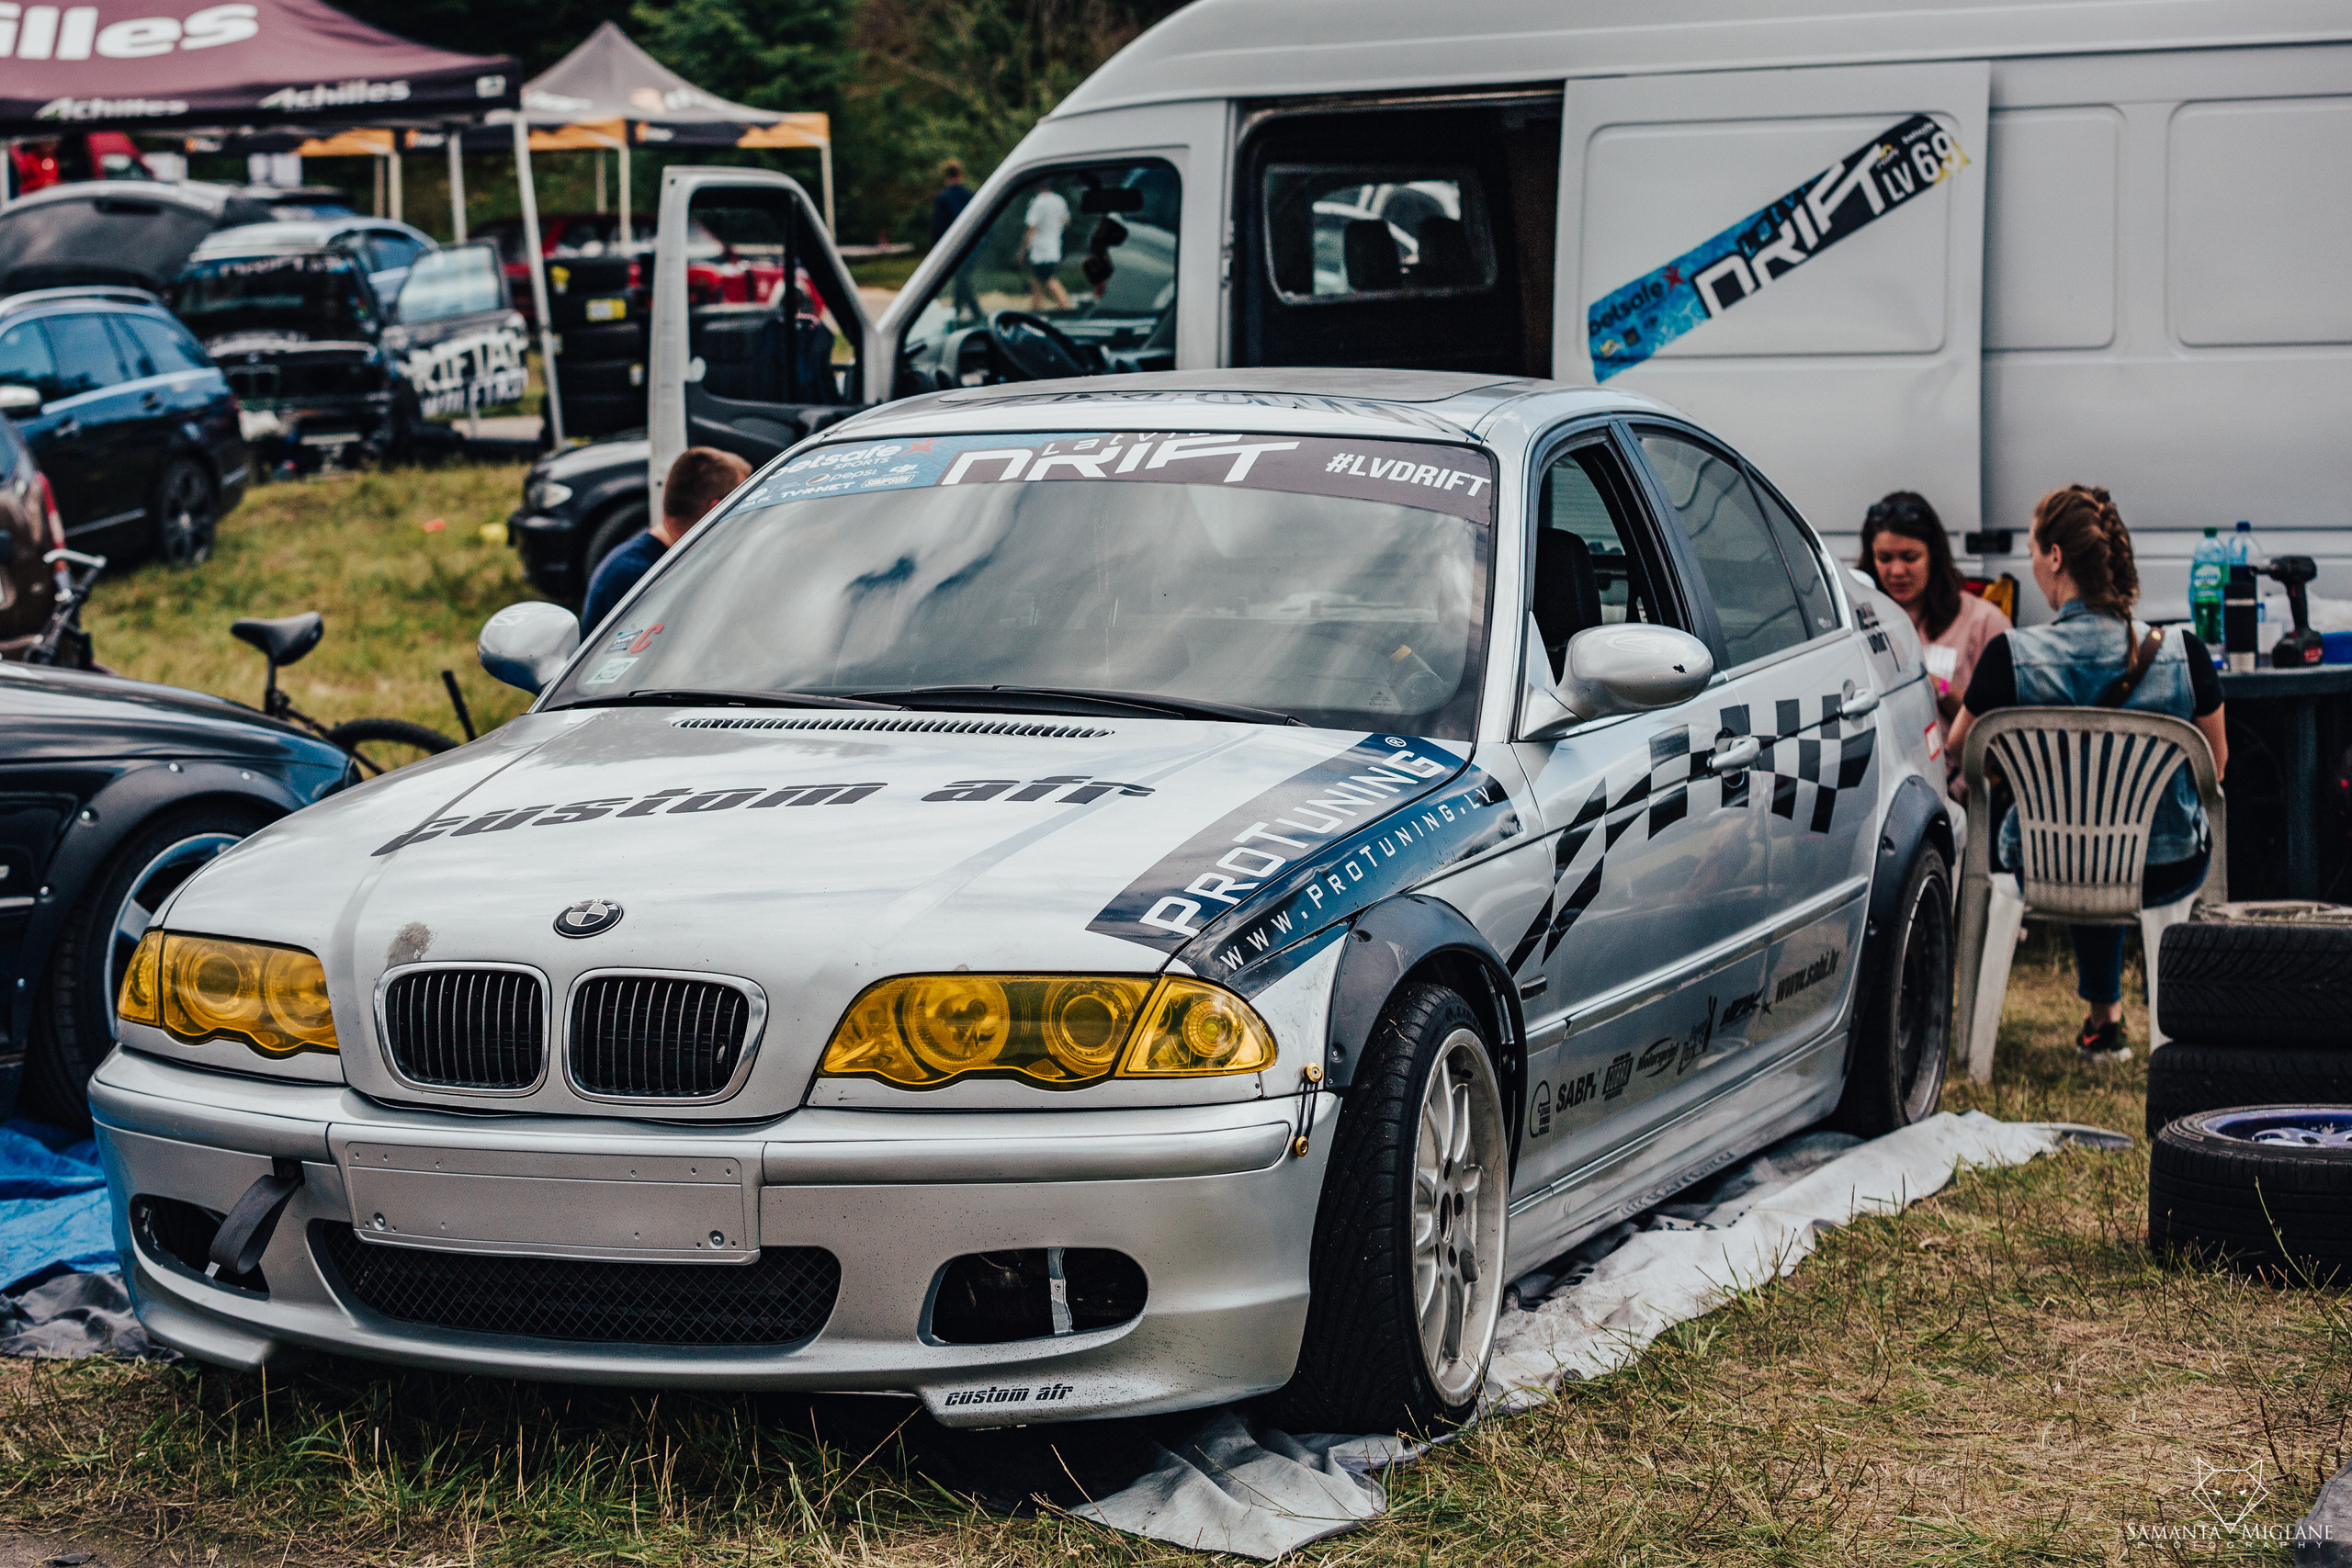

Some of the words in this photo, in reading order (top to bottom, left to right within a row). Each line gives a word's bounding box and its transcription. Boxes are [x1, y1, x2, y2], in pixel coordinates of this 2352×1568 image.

[1882, 161, 1916, 202] LV
[1910, 130, 1957, 184] 69
[829, 468, 878, 483] pepsi
[832, 457, 891, 470] SPORTS
[941, 434, 1301, 486] DRIFT
[1325, 453, 1491, 497] #LVDRIFT
[371, 782, 888, 857] custom
[944, 1386, 1030, 1406] custom
